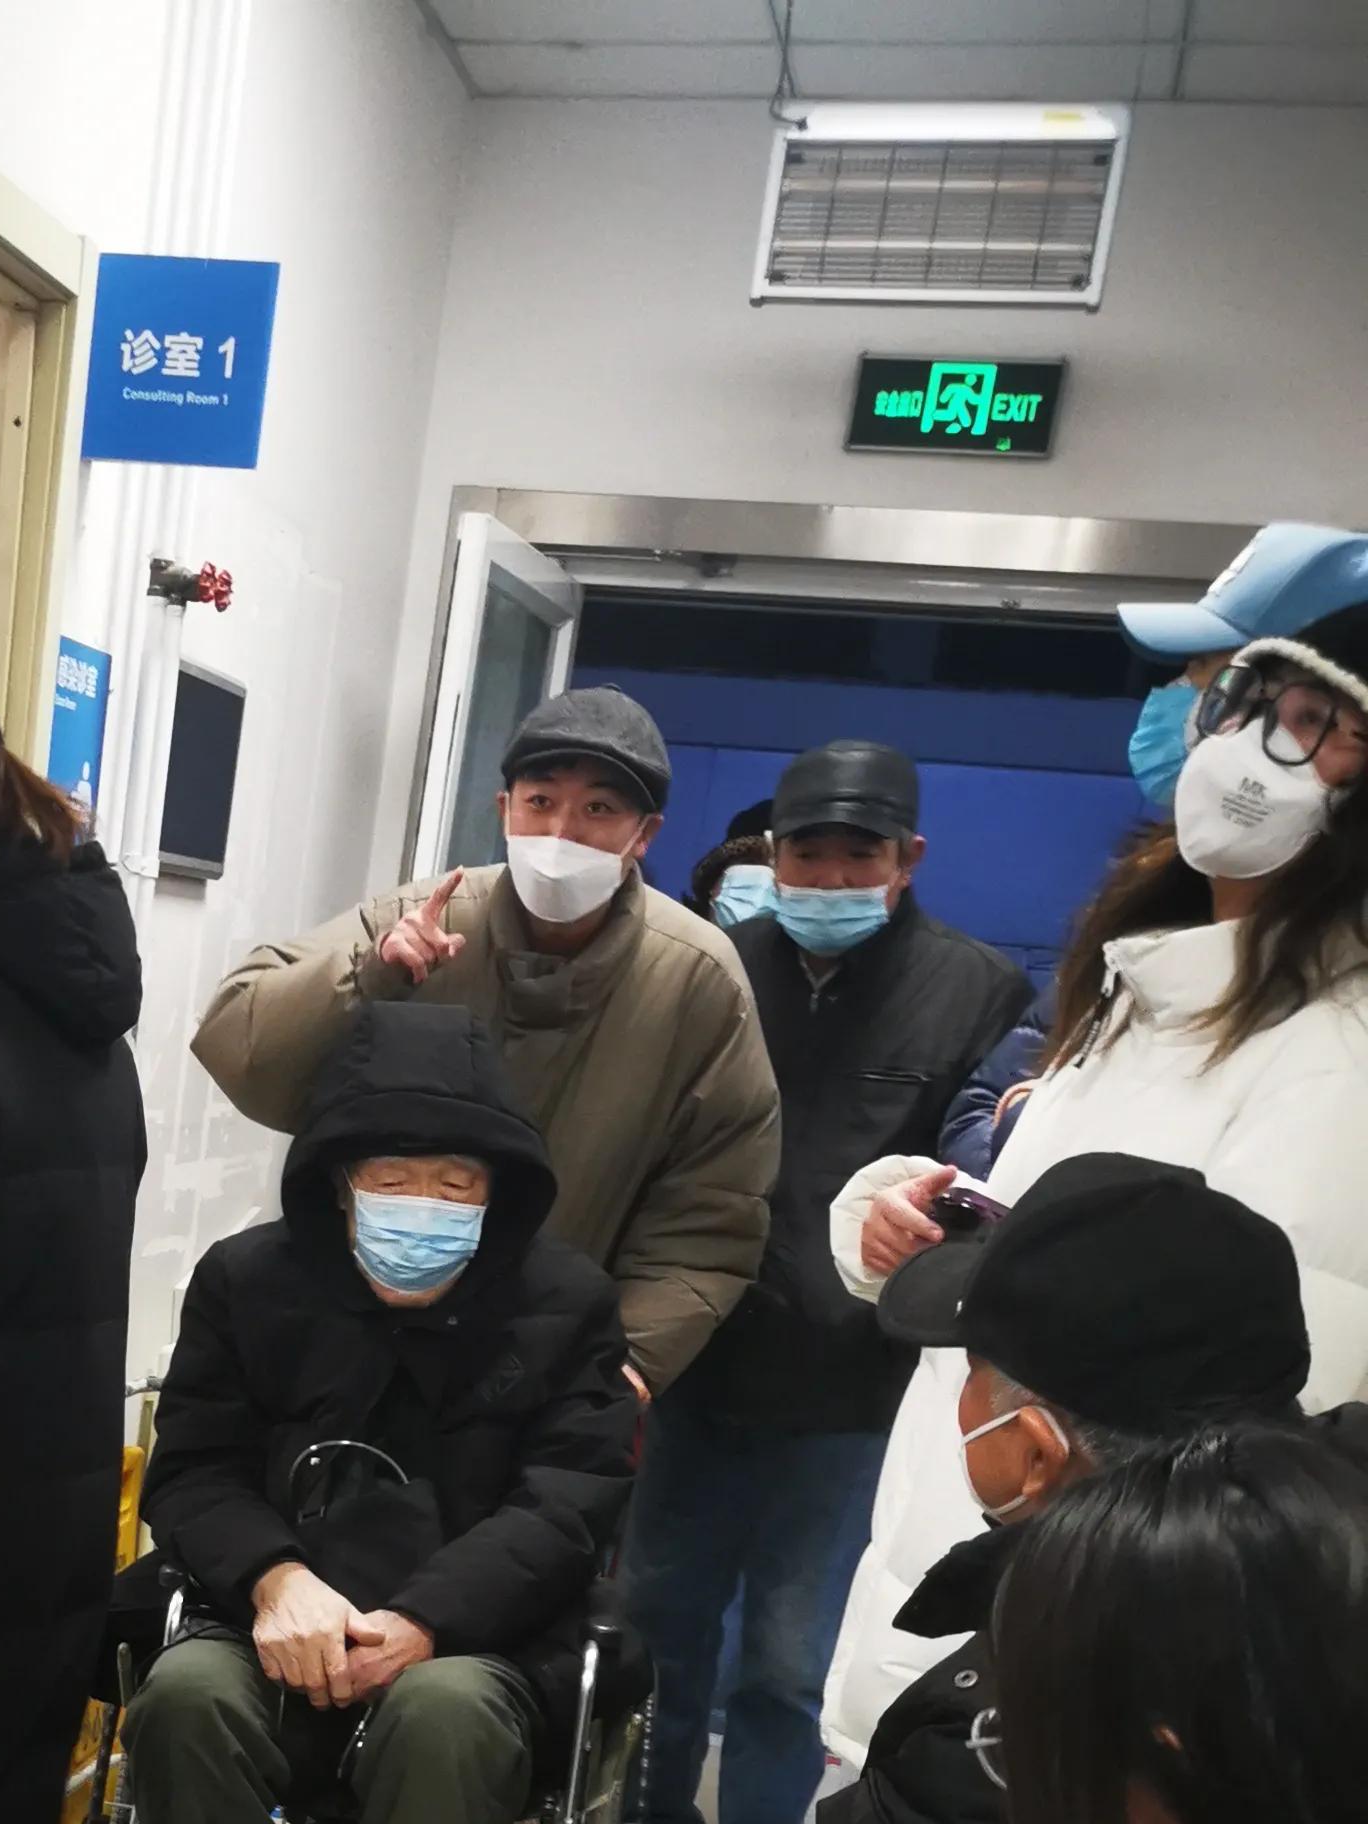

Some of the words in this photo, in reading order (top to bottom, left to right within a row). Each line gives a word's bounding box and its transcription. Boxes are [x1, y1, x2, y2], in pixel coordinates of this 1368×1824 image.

[120, 328, 204, 378] 诊室
[218, 336, 236, 379] 1
[122, 386, 184, 407] Consulting
[186, 391, 220, 405] Room
[991, 393, 1043, 422] EXIT
